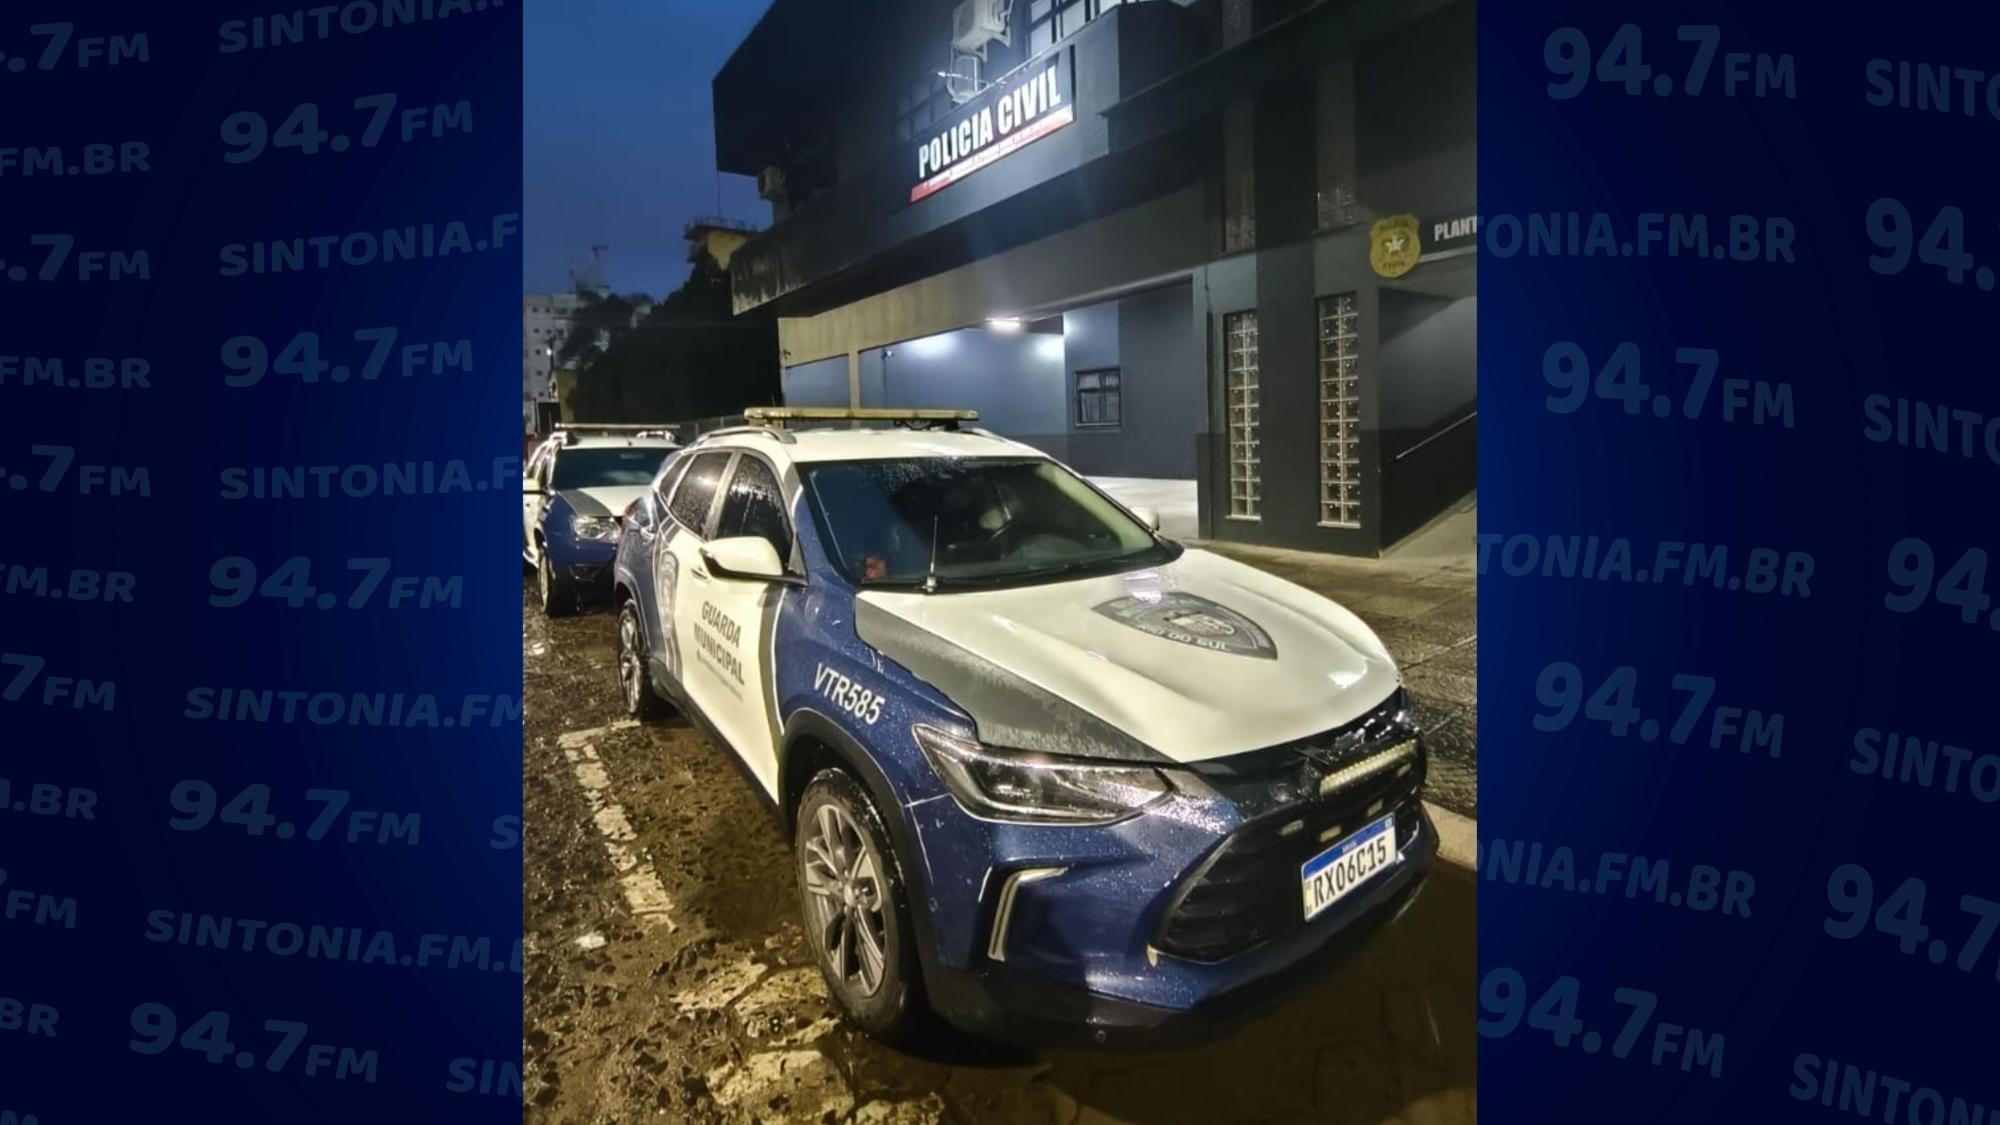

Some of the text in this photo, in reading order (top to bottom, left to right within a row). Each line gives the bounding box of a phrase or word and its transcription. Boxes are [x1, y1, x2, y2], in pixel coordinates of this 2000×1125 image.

[918, 105, 995, 179] POLICIA
[997, 65, 1062, 135] CIVIL
[694, 622, 745, 686] MUNICIPAL
[701, 601, 741, 648] GUARDA
[813, 663, 886, 725] VTR585
